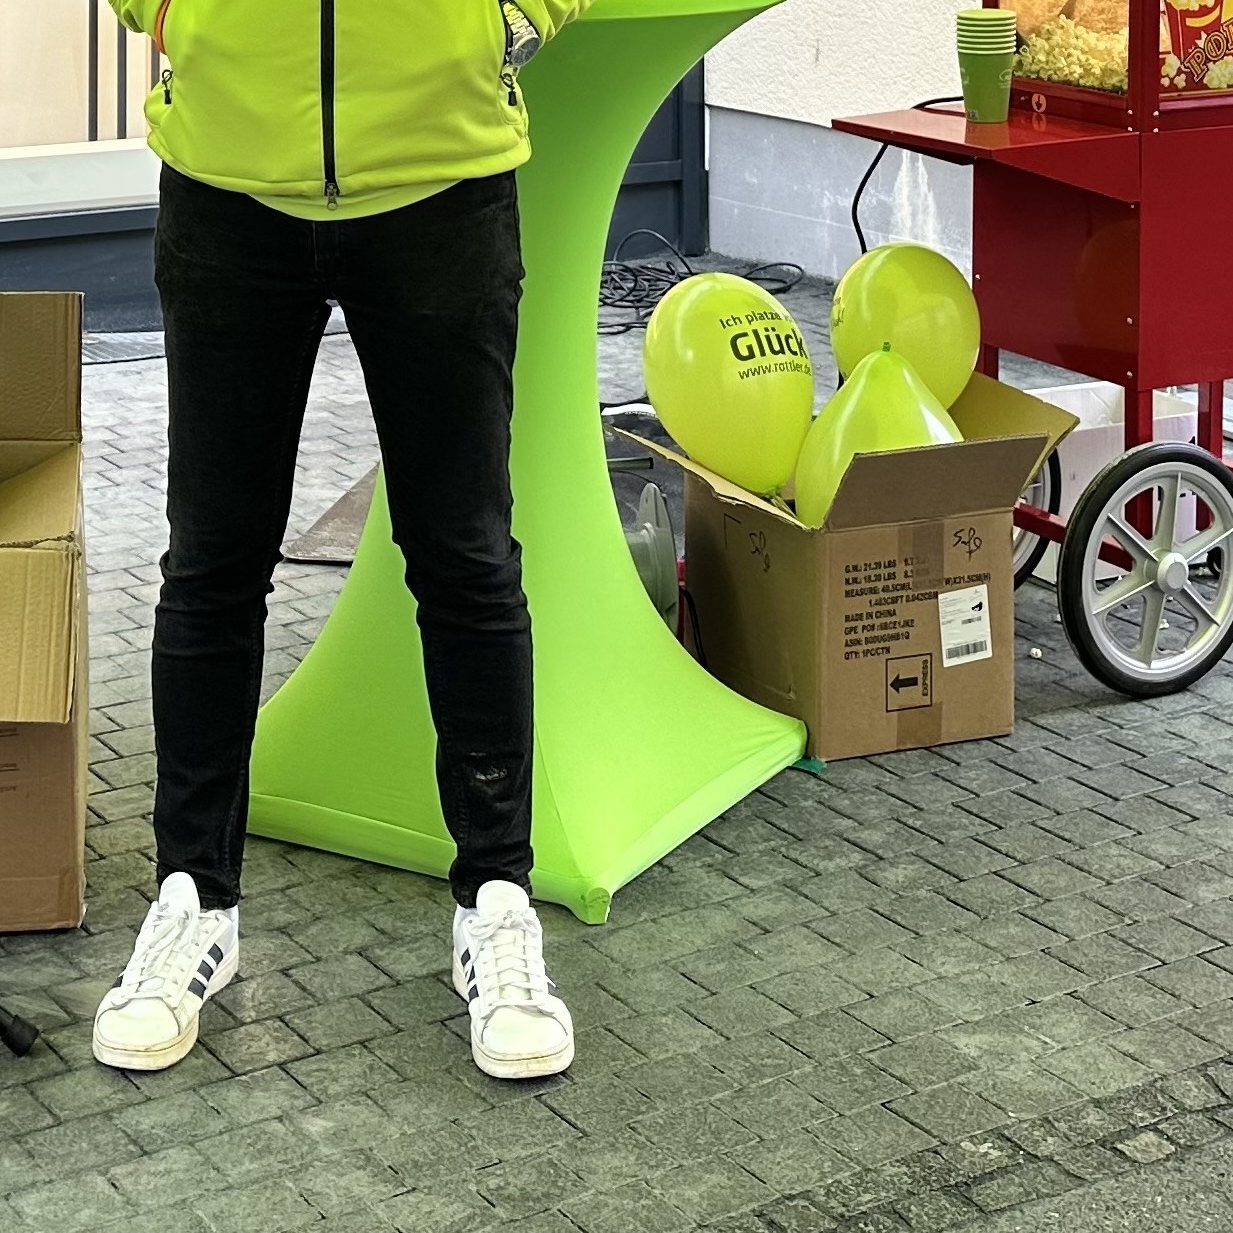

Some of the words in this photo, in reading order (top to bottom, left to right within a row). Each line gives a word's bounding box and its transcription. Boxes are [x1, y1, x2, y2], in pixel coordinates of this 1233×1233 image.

[719, 314, 742, 329] Ich
[745, 310, 782, 326] platze
[729, 326, 809, 362] Glück
[844, 585, 880, 598] MEASURE:
[844, 614, 863, 624] MADE
[863, 612, 873, 622] IN
[874, 608, 897, 620] CHINA
